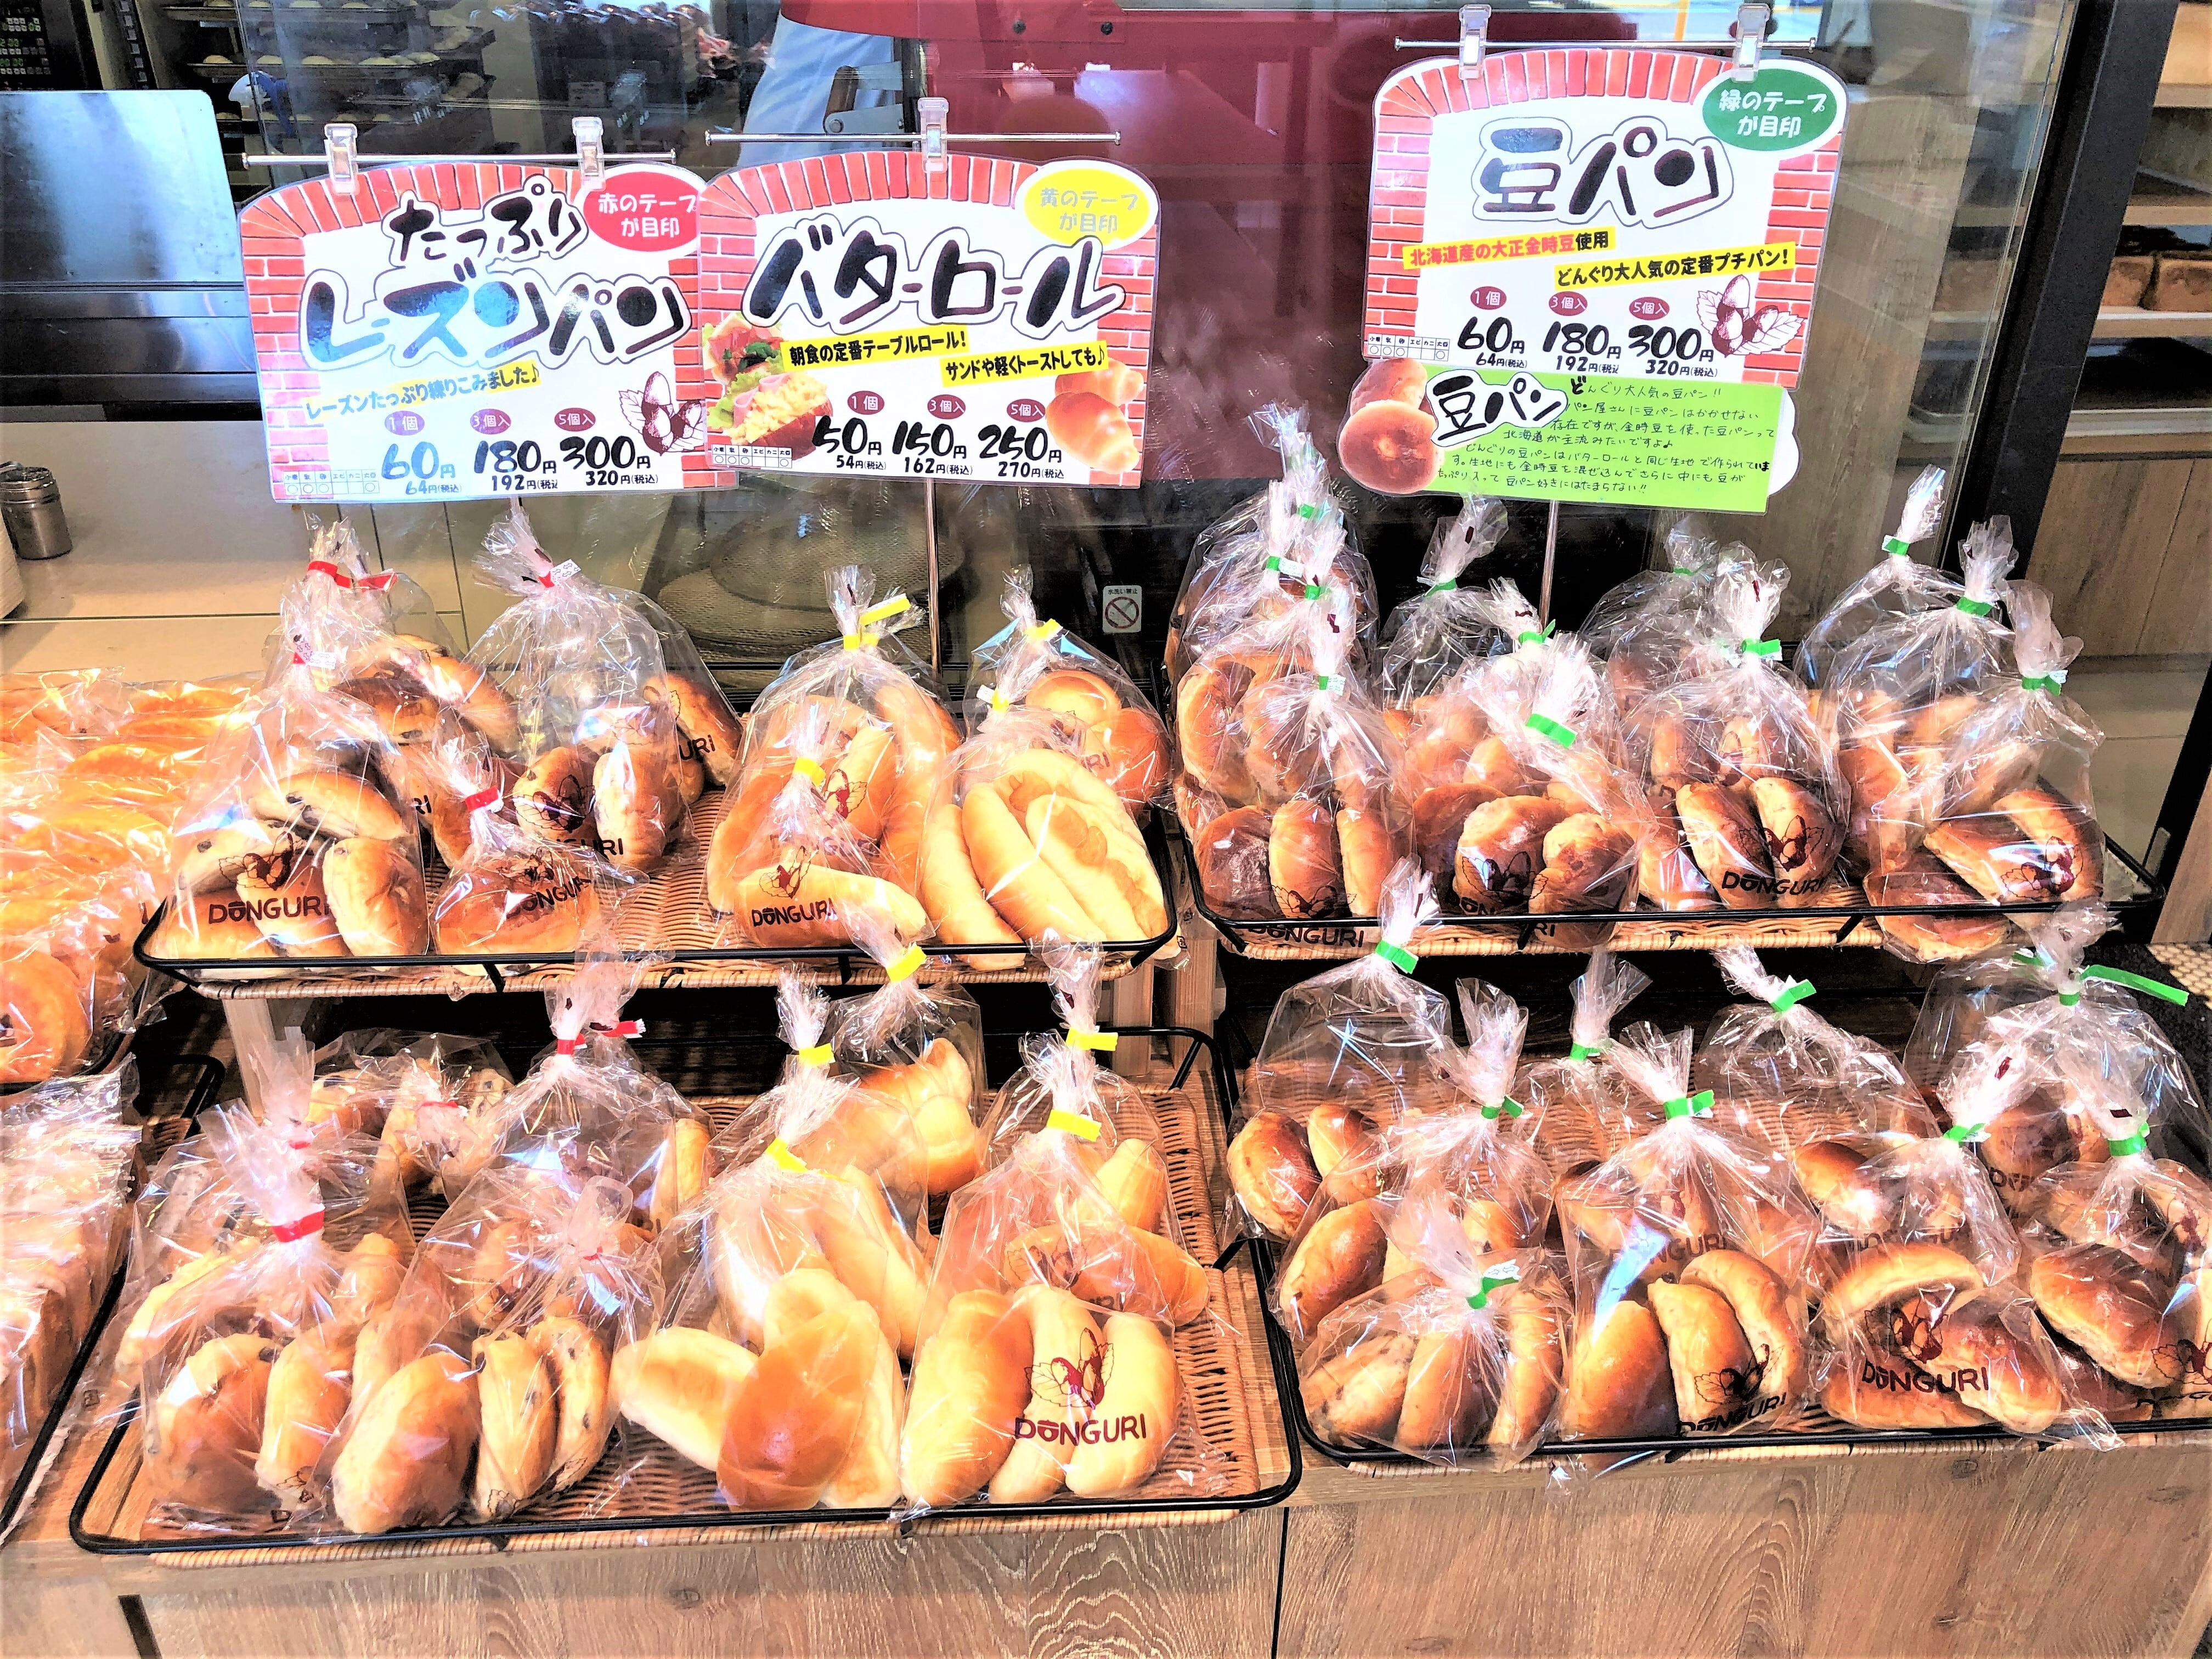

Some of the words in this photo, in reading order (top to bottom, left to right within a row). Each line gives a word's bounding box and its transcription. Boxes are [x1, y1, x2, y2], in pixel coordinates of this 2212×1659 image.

[1719, 89, 1827, 114] 緑のテープ
[1737, 115, 1801, 138] が目印
[1480, 126, 1719, 218] 豆パン
[598, 193, 697, 214] 赤のテープ
[388, 182, 585, 261] たっぷり
[621, 217, 680, 238] が目印
[1059, 212, 1117, 233] が目印
[1409, 231, 1609, 267] 北海道産の大正金時豆使用
[749, 224, 1118, 328] バターロール
[307, 259, 682, 362] レーズンパン
[1433, 375, 1562, 441] 豆パン
[1015, 1413, 1146, 1446] DONGURI
